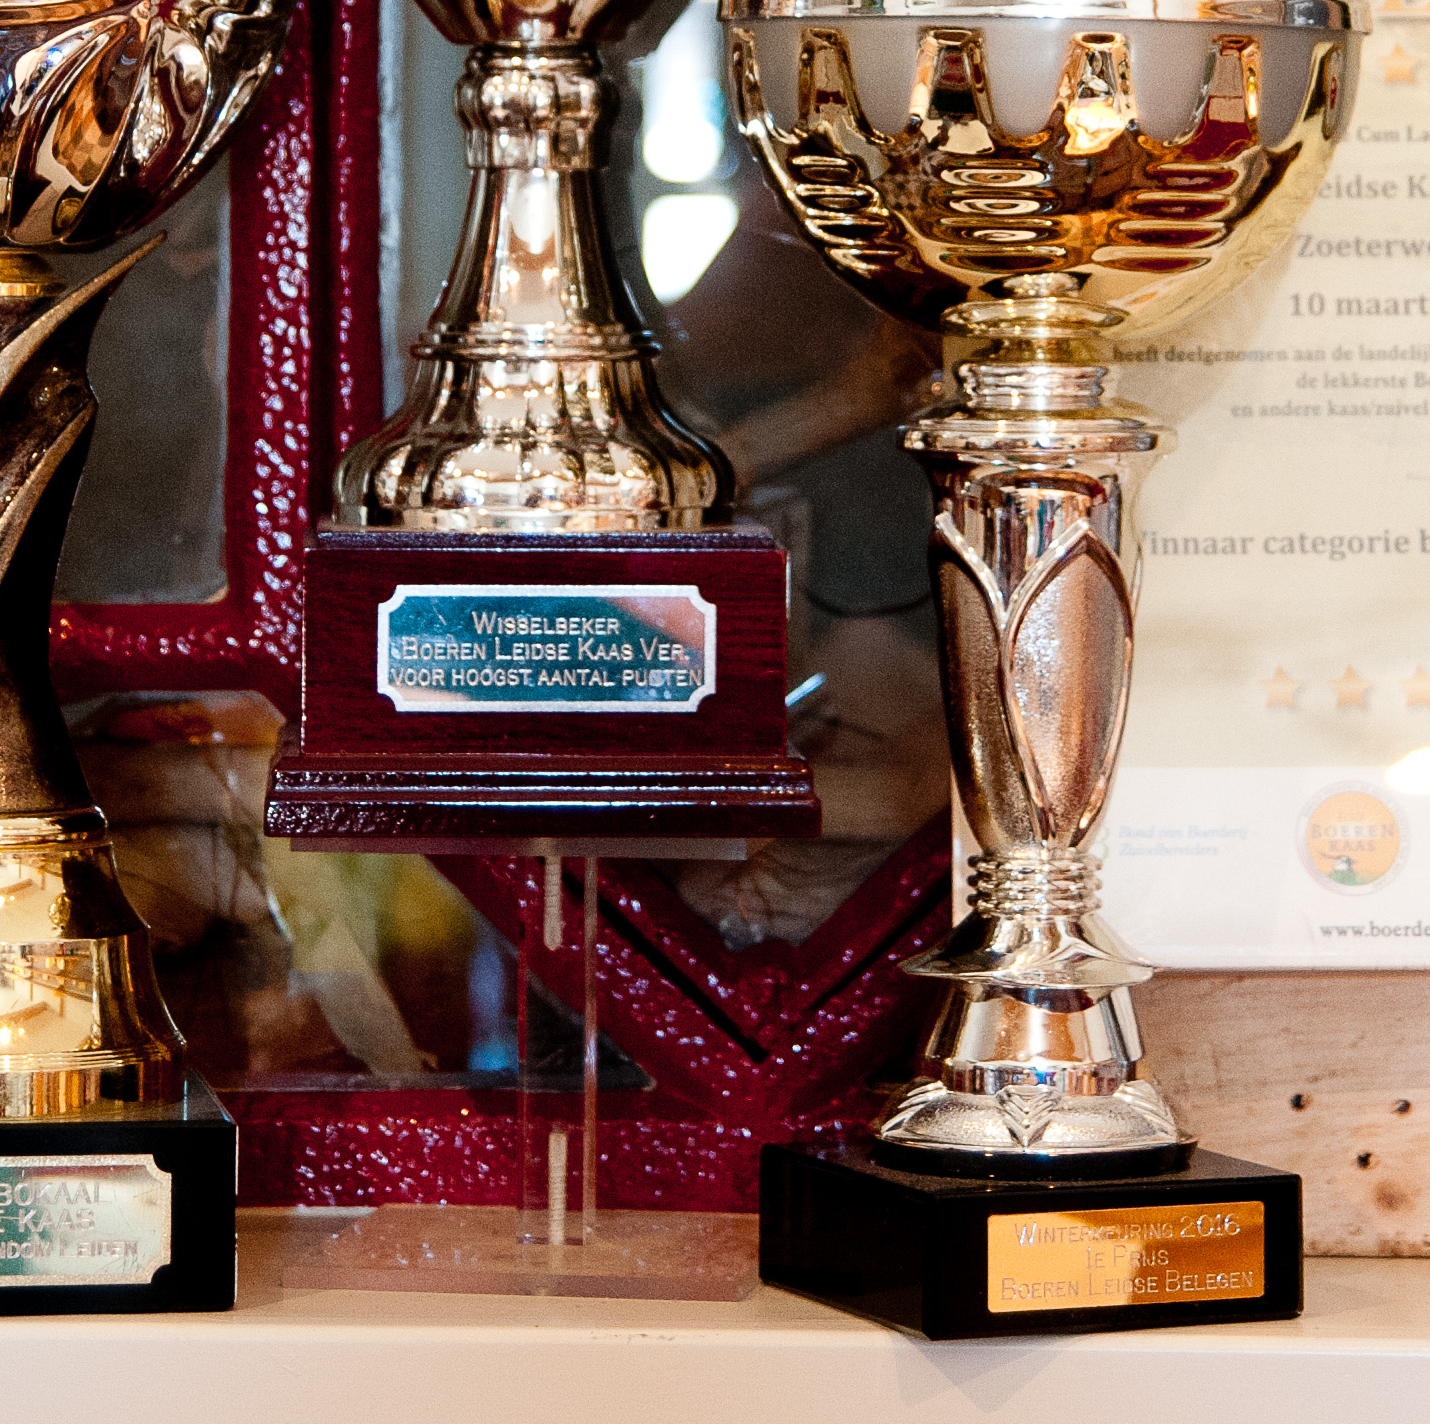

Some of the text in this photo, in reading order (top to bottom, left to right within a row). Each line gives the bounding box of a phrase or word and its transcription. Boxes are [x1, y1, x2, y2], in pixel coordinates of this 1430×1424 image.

[1356, 126, 1400, 143] Cum
[1289, 291, 1326, 317] 10
[1335, 292, 1430, 317] maart
[1164, 344, 1288, 366] deelgenomen
[1293, 348, 1326, 362] aan
[1332, 344, 1352, 361] de
[1296, 371, 1318, 389] de
[1323, 371, 1408, 389] lekkerste
[1230, 404, 1254, 418] en
[1259, 400, 1321, 418] andere
[1141, 531, 1254, 556] innaar
[1262, 531, 1411, 561] categorie
[391, 668, 445, 687] VOOR
[451, 668, 532, 687] HOOGST
[537, 668, 616, 687] AANTAL
[1310, 823, 1397, 840] BOEREN
[1328, 839, 1377, 853] KAAS
[17, 1207, 96, 1234] KAAS
[1179, 1212, 1241, 1240] 2016
